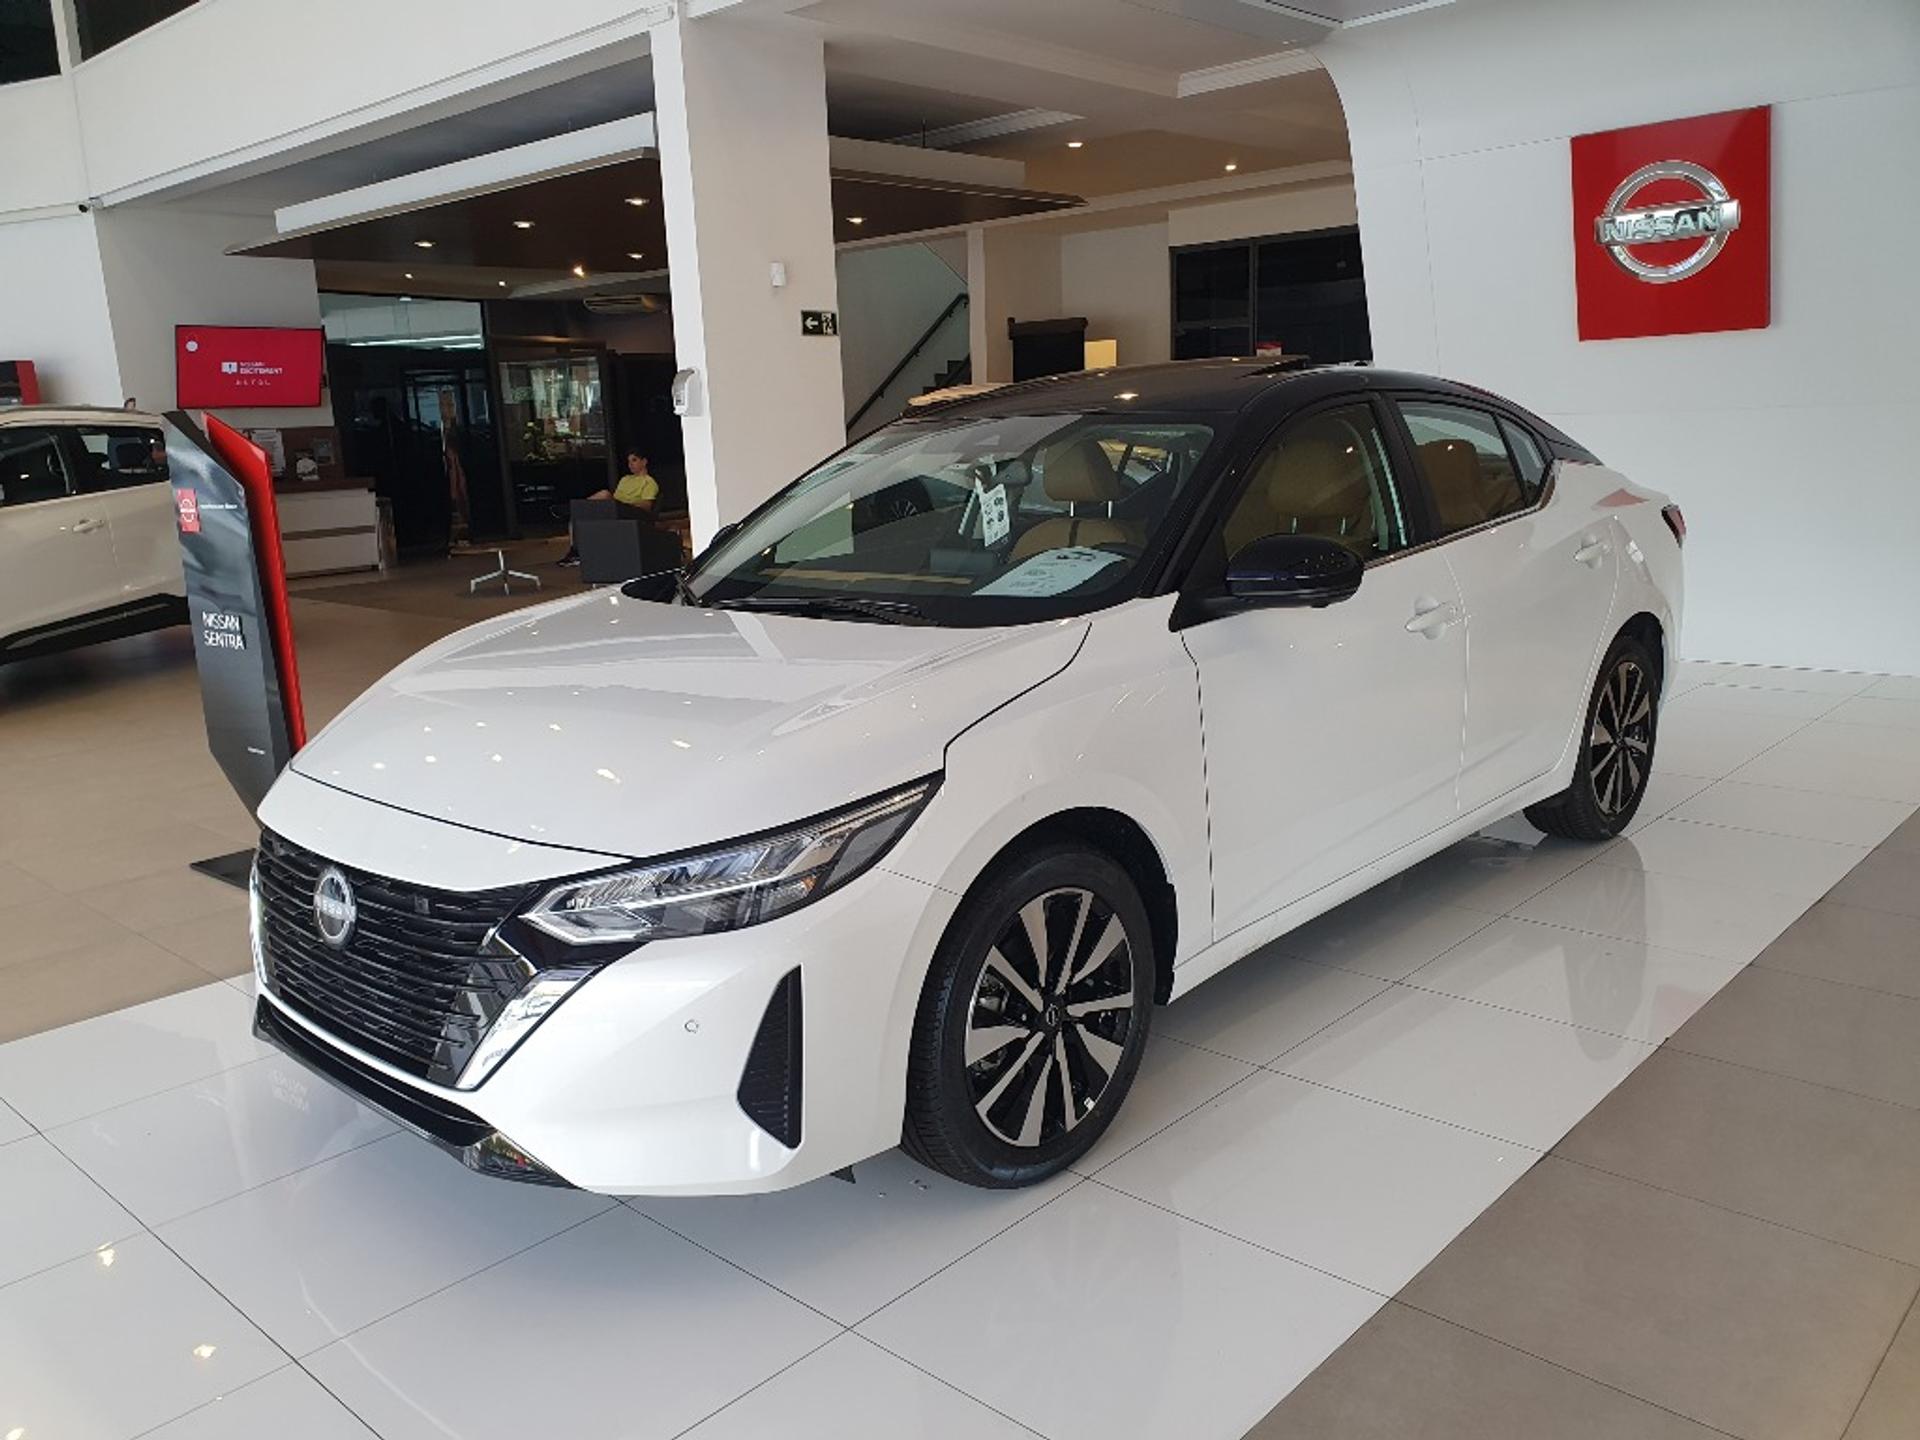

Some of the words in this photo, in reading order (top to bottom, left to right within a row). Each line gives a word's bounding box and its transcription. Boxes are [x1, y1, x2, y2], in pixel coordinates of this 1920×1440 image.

[1604, 205, 1722, 241] NISSAN
[202, 611, 240, 631] NISSAN
[204, 630, 245, 650] SENTRA
